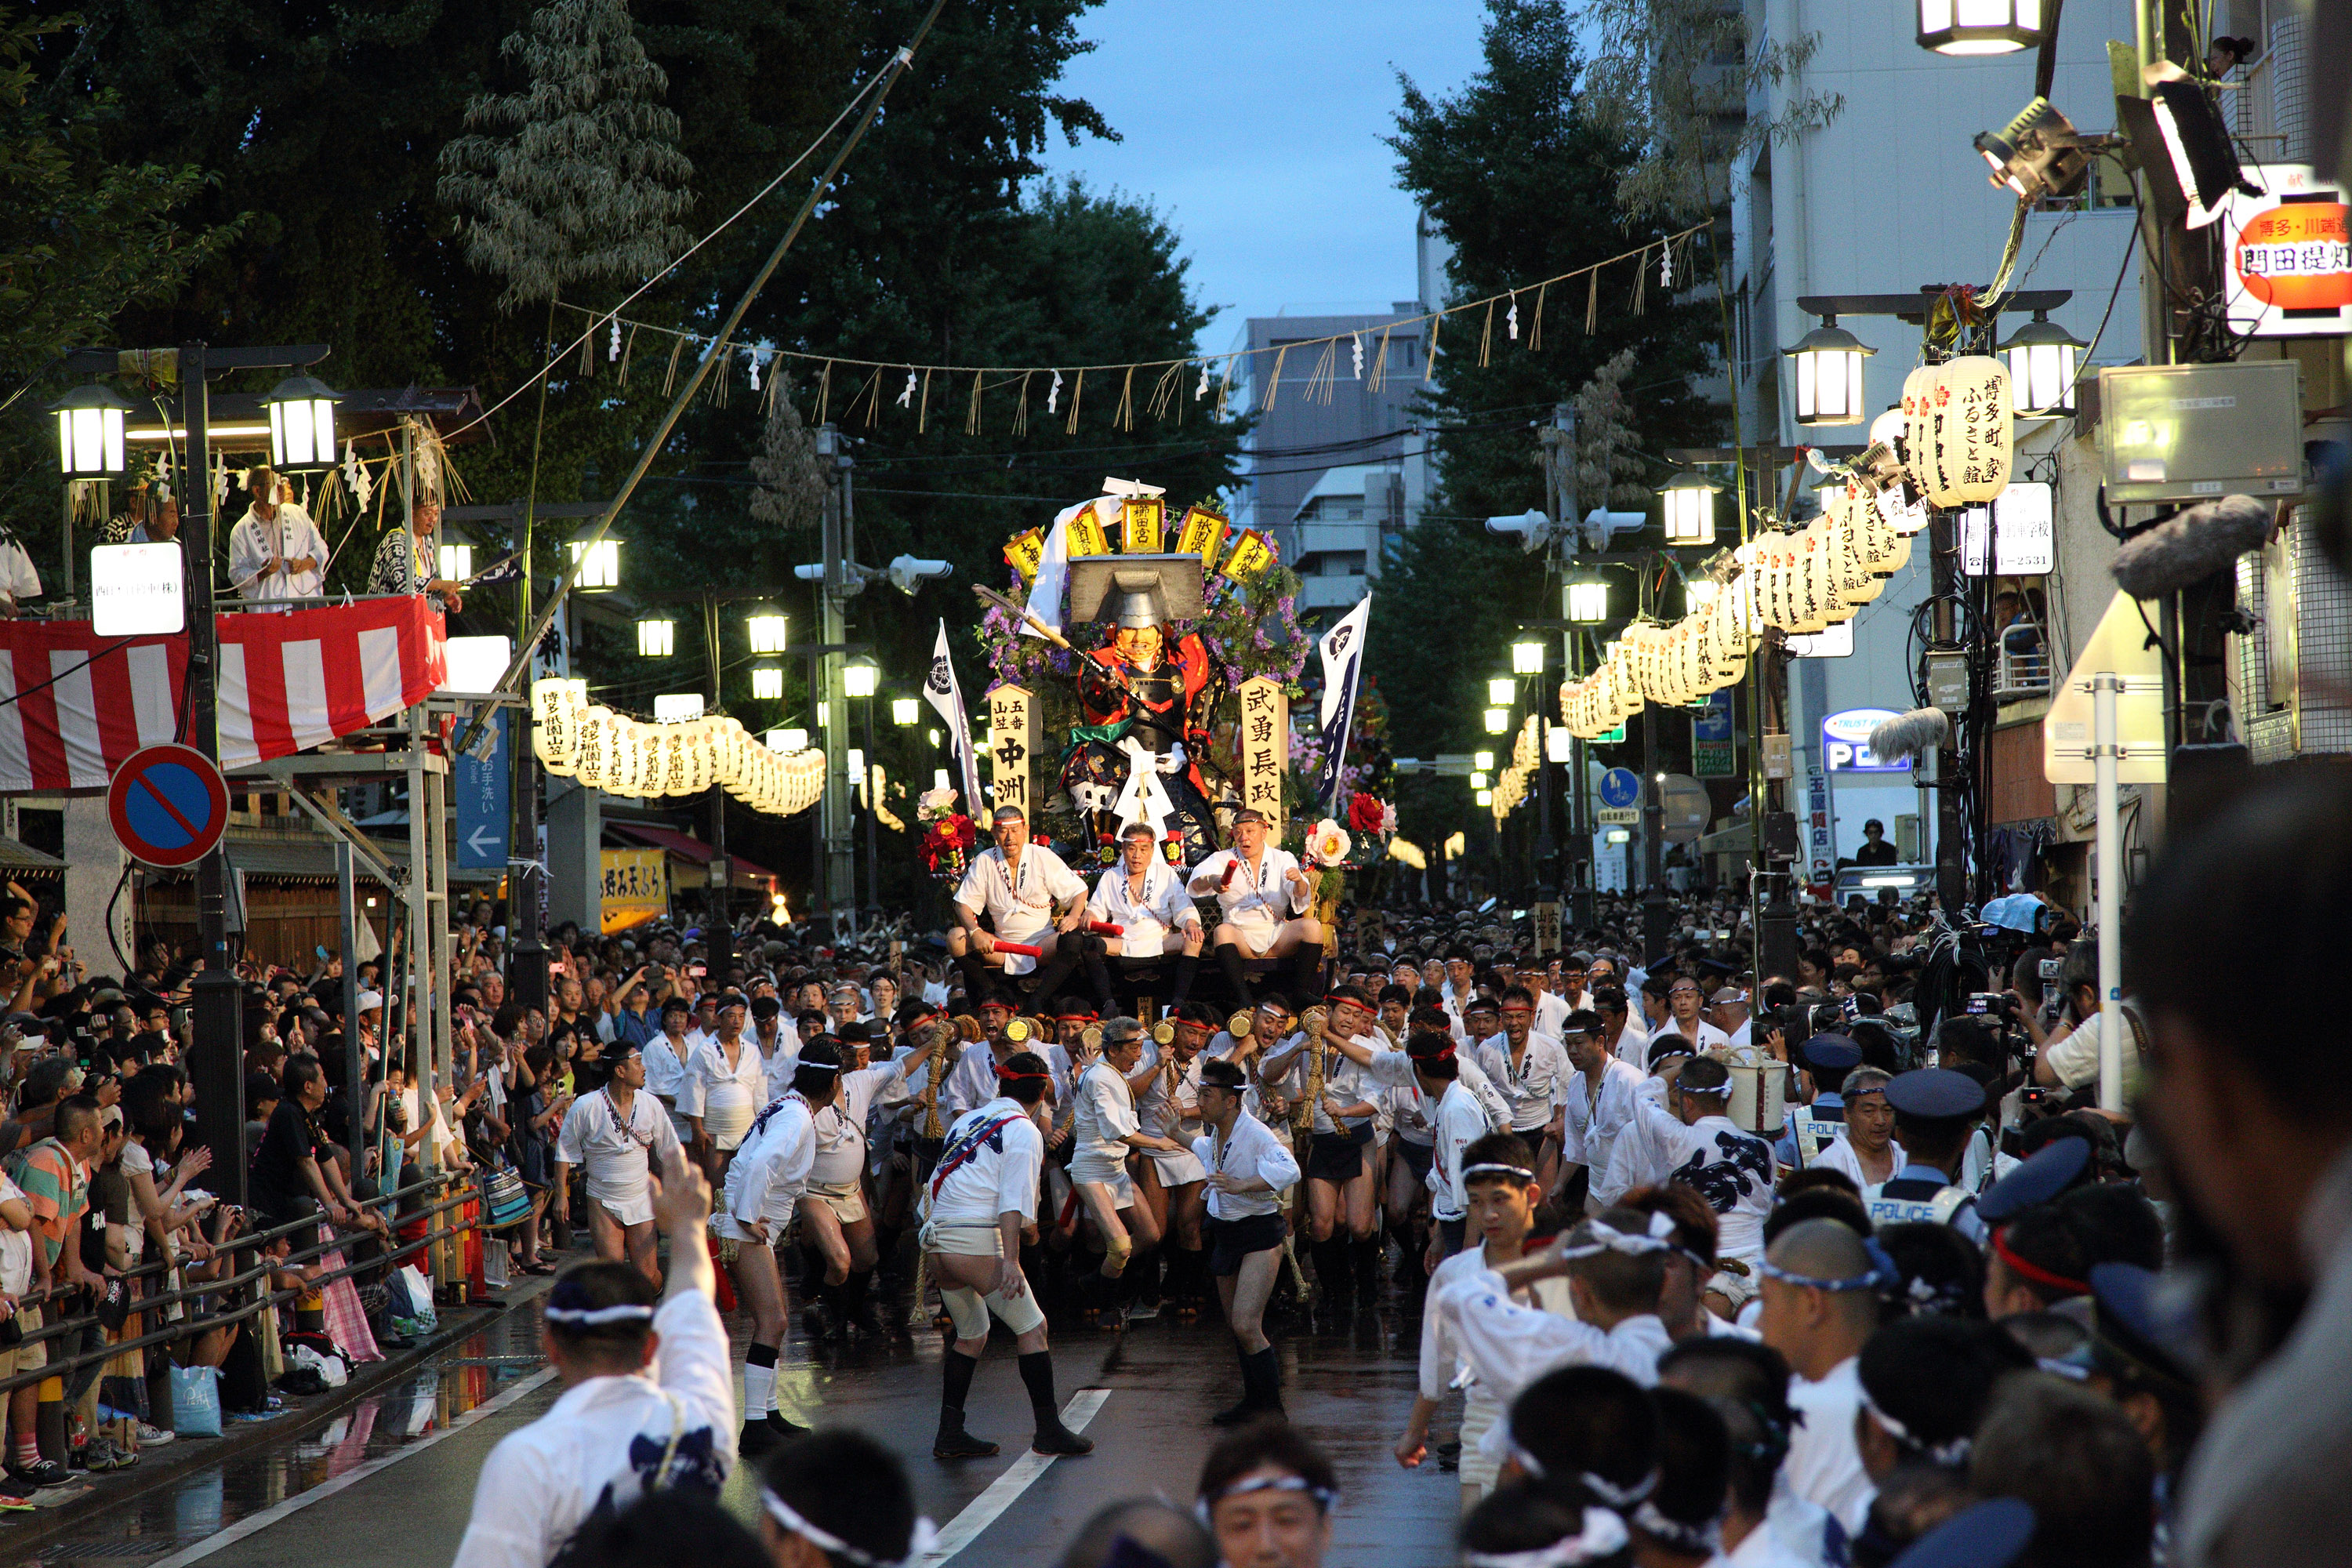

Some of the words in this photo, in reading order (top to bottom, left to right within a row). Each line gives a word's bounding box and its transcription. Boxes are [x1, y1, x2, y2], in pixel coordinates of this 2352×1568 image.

[1962, 388, 1982, 485] ふるさと館
[543, 691, 564, 755] 博多祇園山笠
[993, 701, 1009, 730] 山笠
[1010, 700, 1025, 730] 五番
[1838, 719, 1867, 728] TRUST
[470, 760, 478, 785] Toilet
[996, 737, 1025, 805] 中洲
[481, 758, 495, 815] お手洗い
[1871, 1203, 1934, 1221] POLICE
